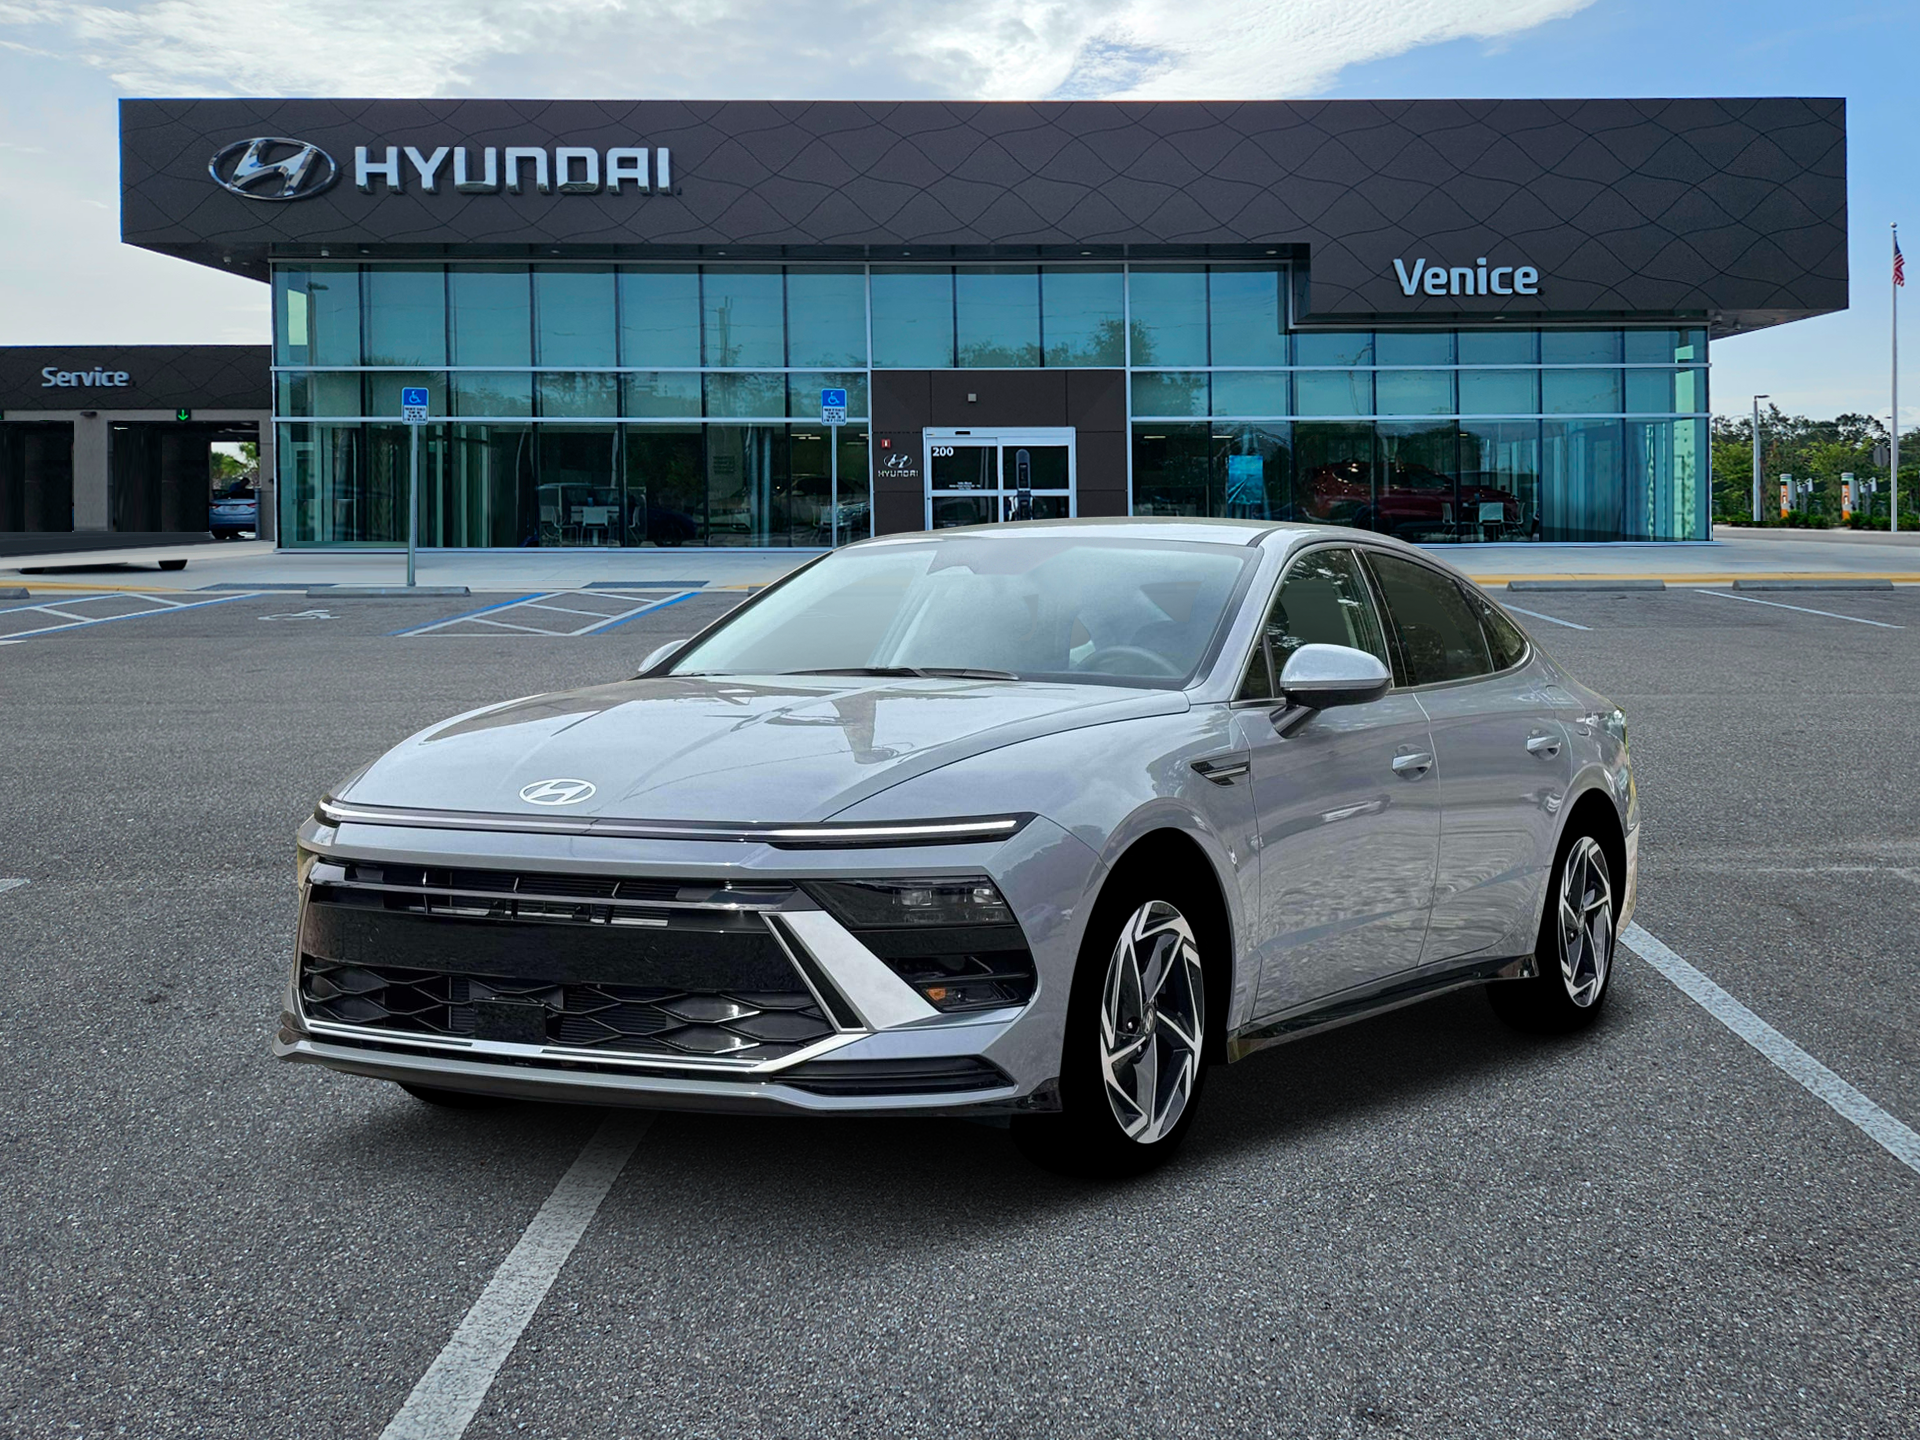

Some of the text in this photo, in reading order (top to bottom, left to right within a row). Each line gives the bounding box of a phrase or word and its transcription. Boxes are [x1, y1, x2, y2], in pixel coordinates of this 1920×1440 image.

[354, 146, 671, 195] HYUNDAI
[1392, 256, 1539, 296] Venice
[41, 366, 130, 387] Service
[932, 446, 955, 457] 200
[878, 470, 919, 478] HYUNDAI
